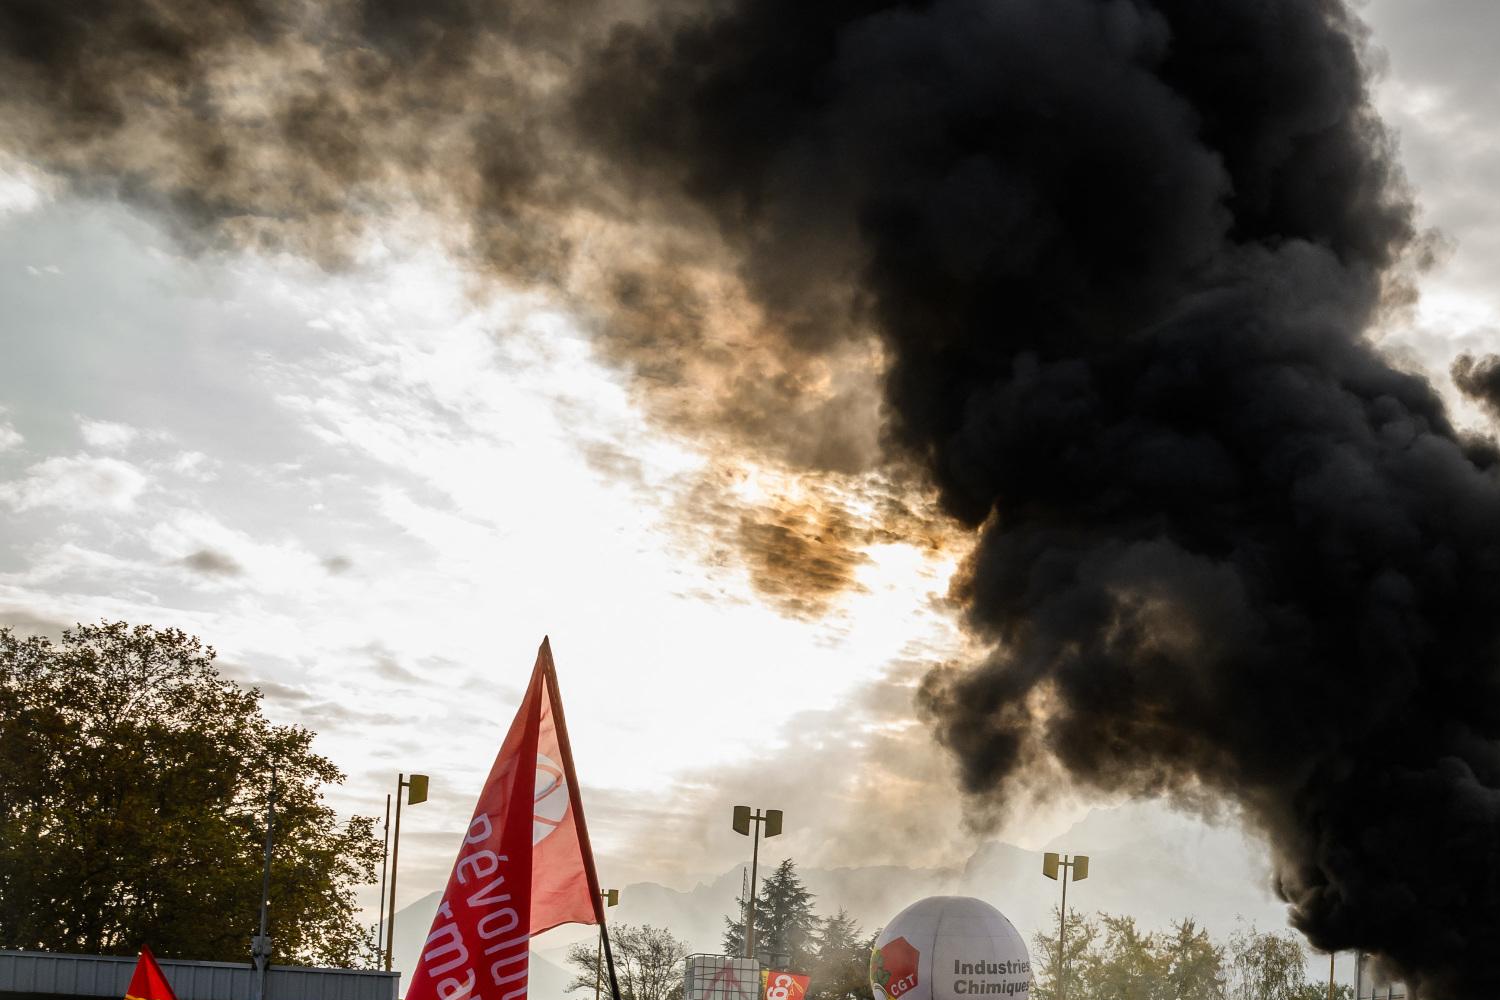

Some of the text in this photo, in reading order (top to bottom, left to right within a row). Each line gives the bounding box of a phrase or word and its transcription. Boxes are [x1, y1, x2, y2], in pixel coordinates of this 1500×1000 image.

[954, 959, 1031, 974] Industries
[890, 973, 917, 996] CGT
[954, 979, 1031, 996] Chimiques
